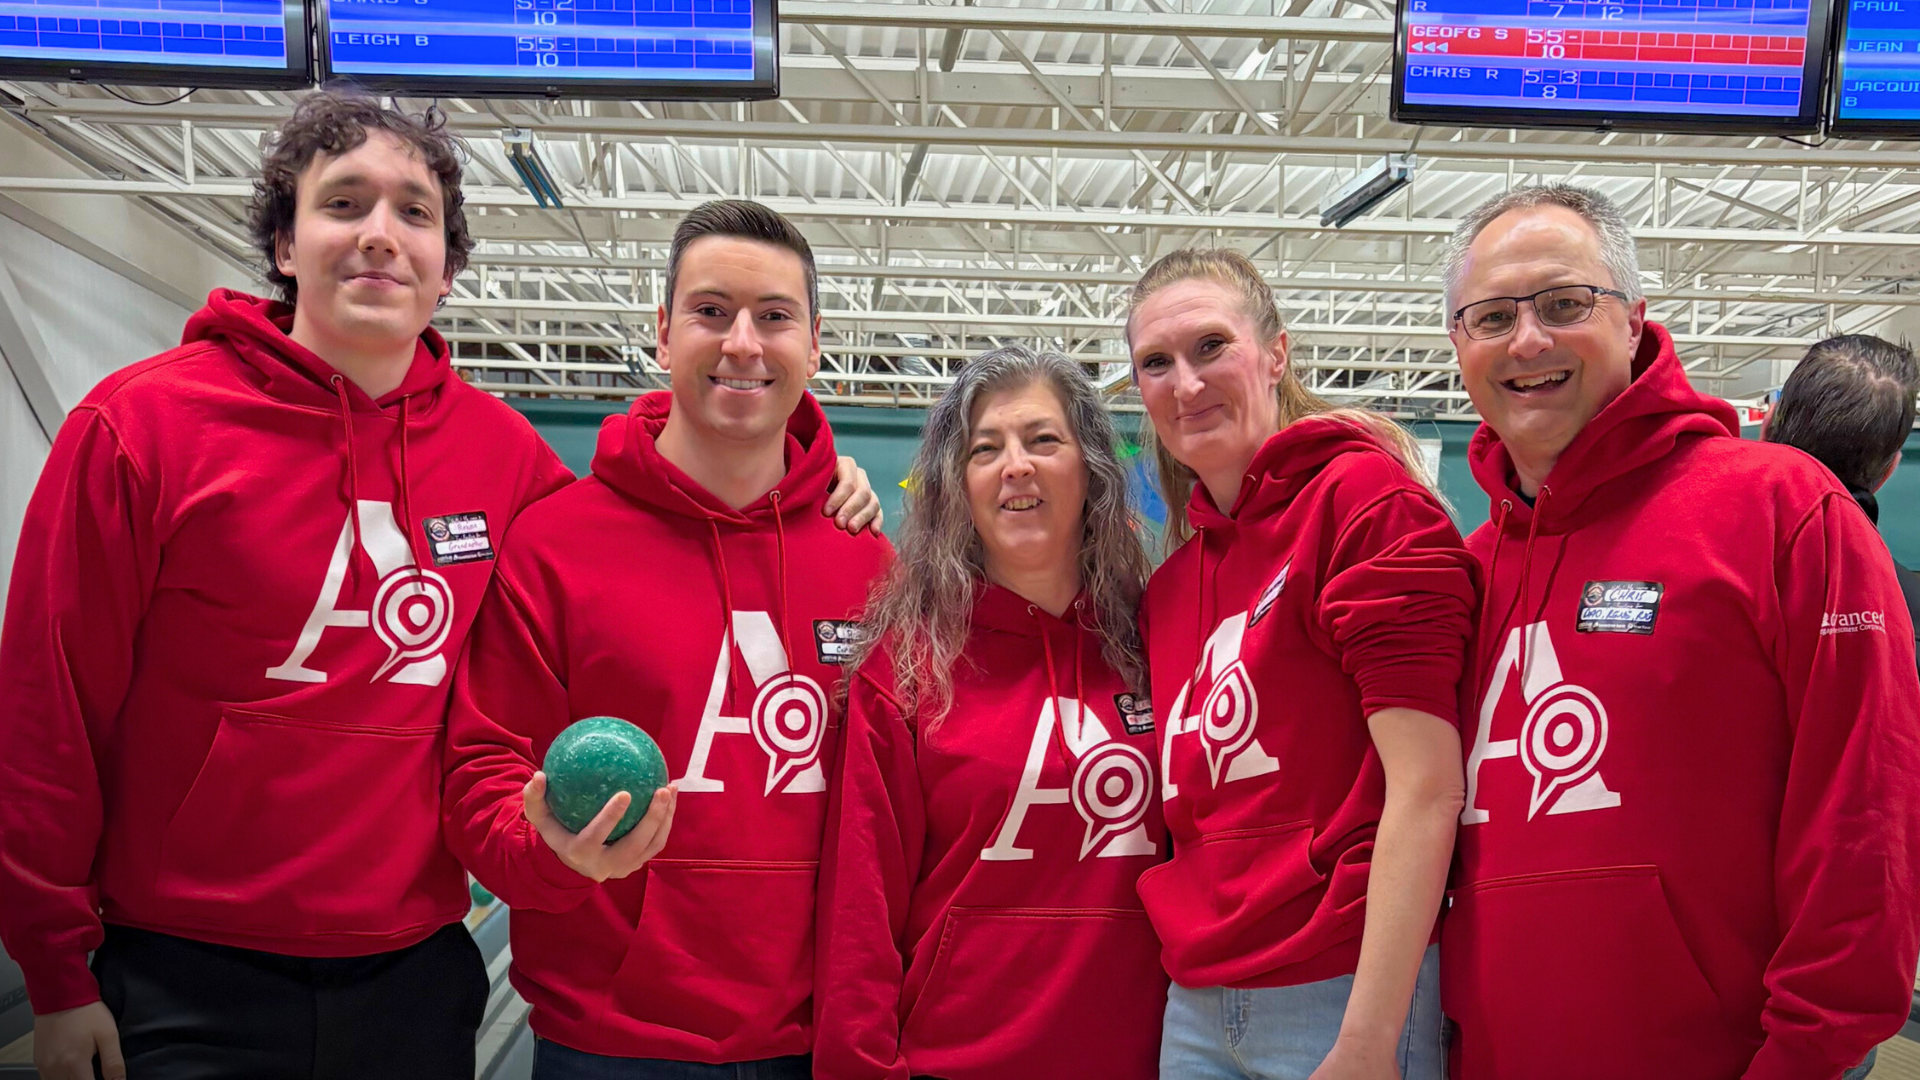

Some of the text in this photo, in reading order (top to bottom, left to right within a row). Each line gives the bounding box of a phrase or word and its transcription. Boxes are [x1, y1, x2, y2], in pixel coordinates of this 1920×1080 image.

[1413, 0, 1427, 12] R
[1549, 3, 1565, 19] 7
[1601, 6, 1624, 20] 12
[1853, 1, 1906, 12] PAUL
[533, 11, 557, 26] 10
[334, 33, 429, 46] LEIGH B
[1412, 25, 1509, 40] GEOFG S
[1541, 44, 1565, 59] 10
[1850, 41, 1904, 52] JEAN
[535, 52, 559, 67] 10
[1410, 66, 1499, 80] CHRIS R
[1542, 85, 1557, 99] 8
[1846, 81, 1920, 93] JACQUI
[1844, 96, 1858, 107] B
[1609, 589, 1647, 601] CHRIS
